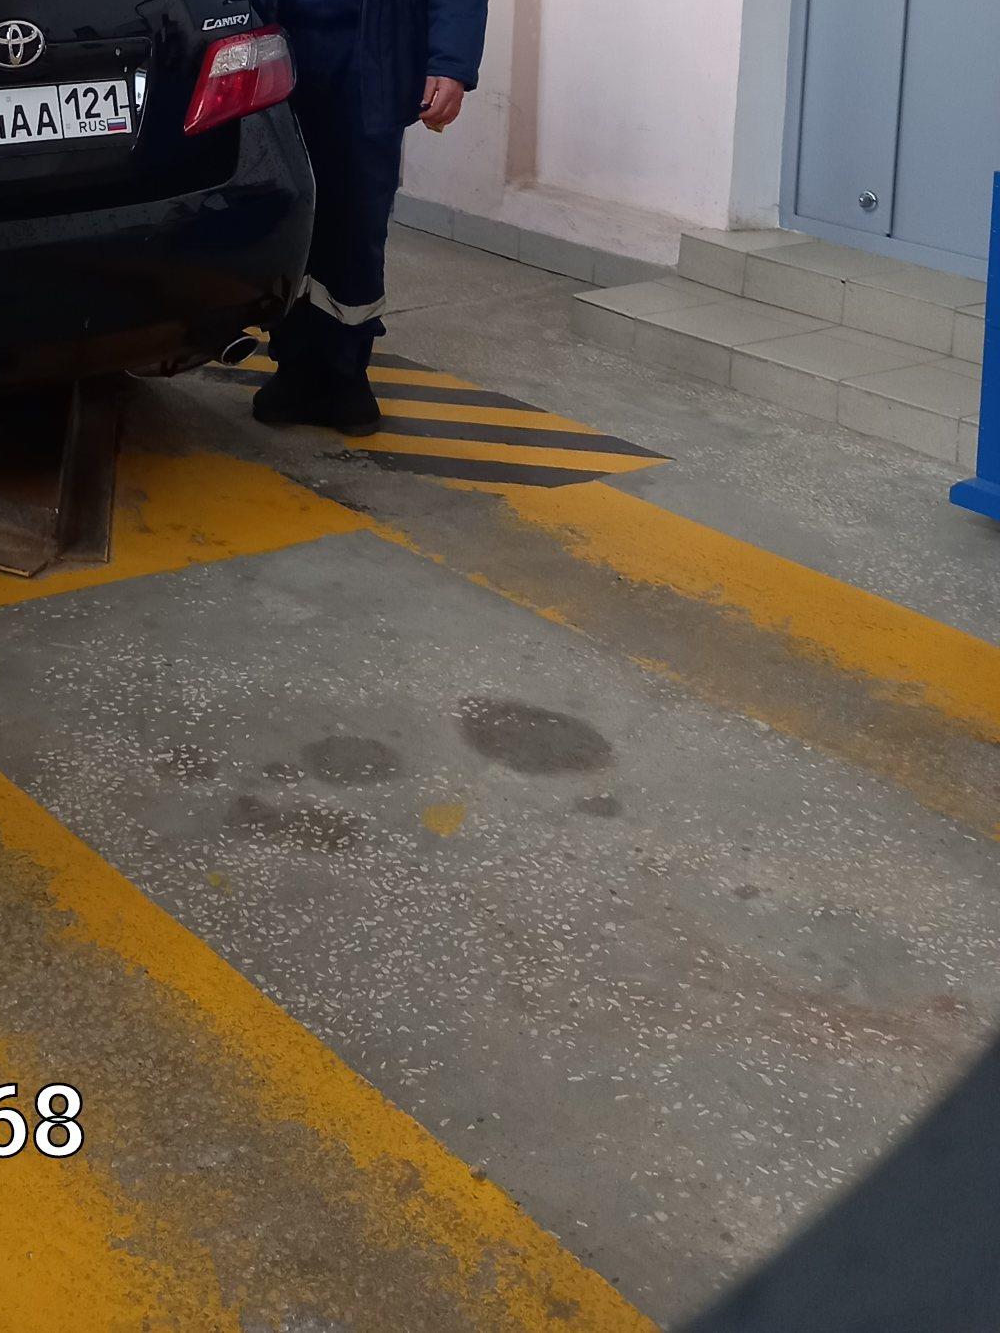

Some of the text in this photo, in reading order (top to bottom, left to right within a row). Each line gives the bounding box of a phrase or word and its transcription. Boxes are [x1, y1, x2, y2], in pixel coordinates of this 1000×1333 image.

[201, 13, 250, 31] CAMRY
[64, 84, 120, 120] 121
[78, 119, 107, 134] RUS
